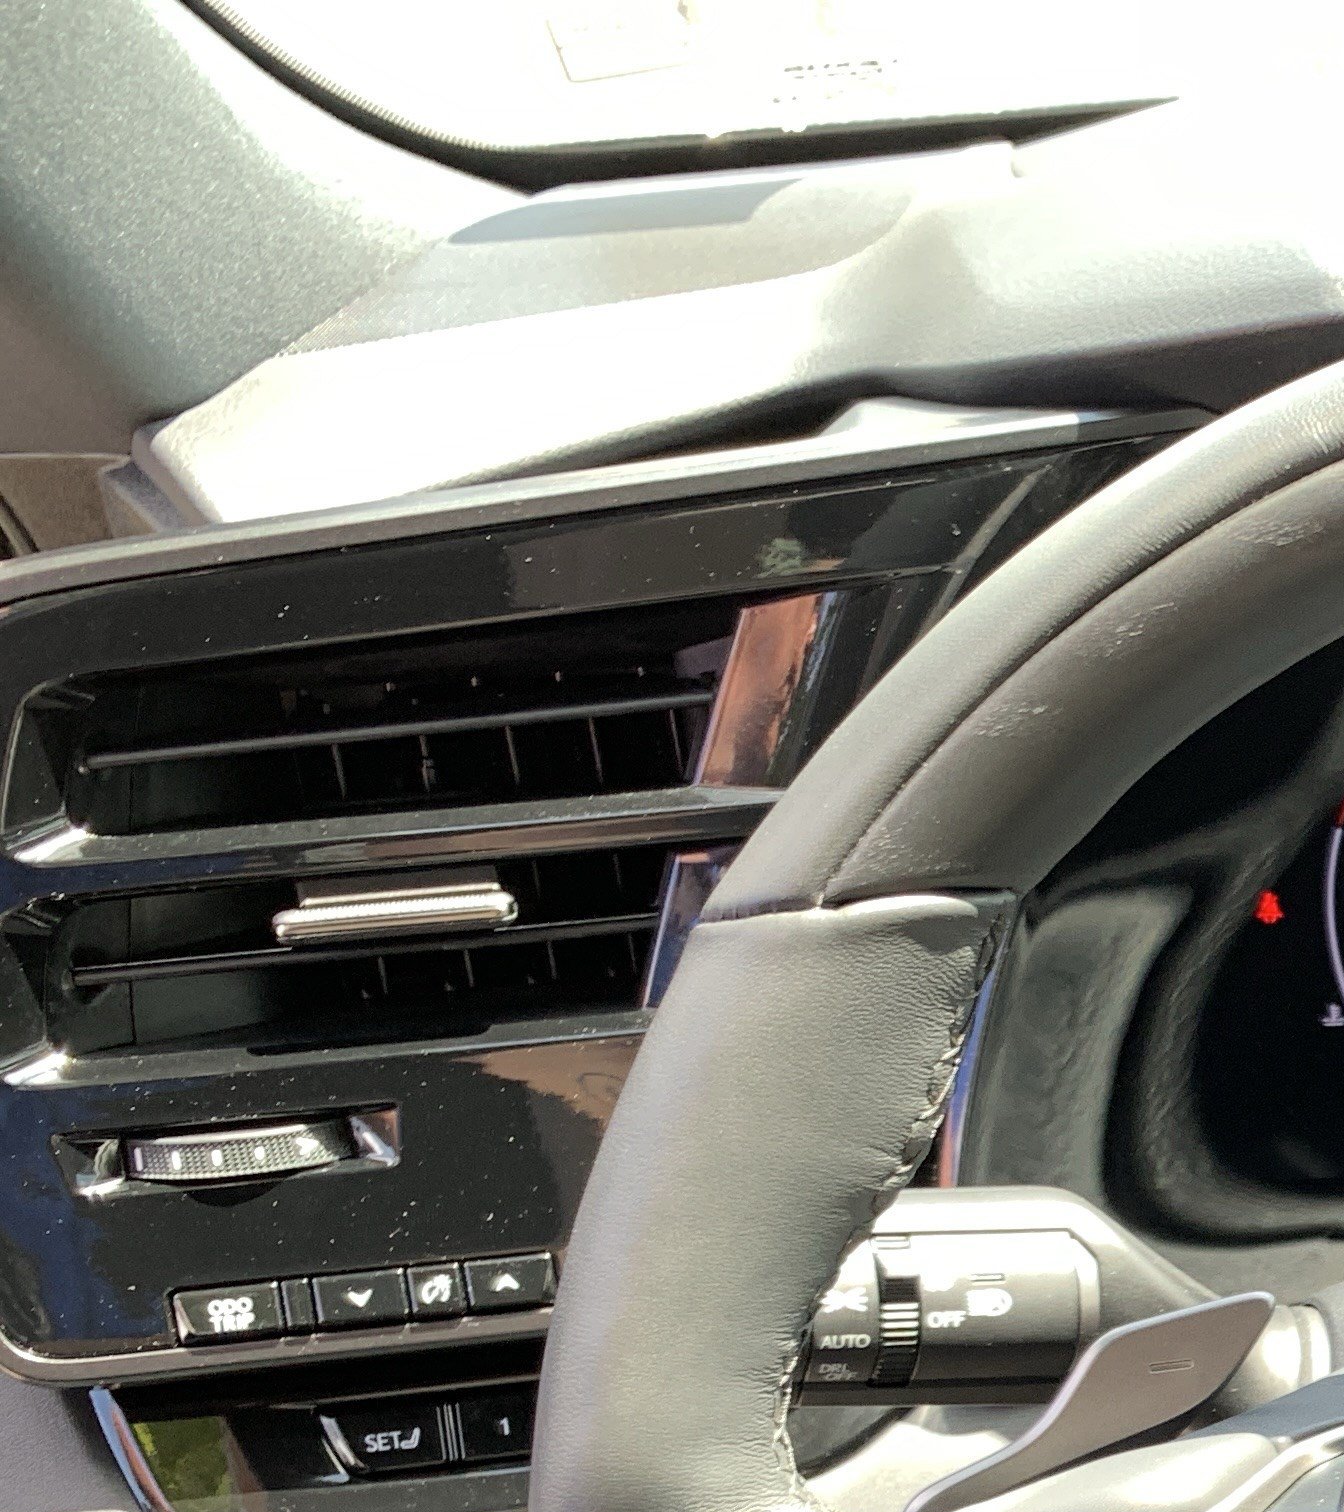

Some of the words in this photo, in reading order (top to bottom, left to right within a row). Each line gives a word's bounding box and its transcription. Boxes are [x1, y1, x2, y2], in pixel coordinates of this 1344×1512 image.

[207, 1296, 254, 1314] ODO
[208, 1311, 256, 1333] TRIP
[926, 1310, 966, 1329] OFF
[820, 1333, 871, 1350] AUTO
[818, 1362, 850, 1375] DRL
[499, 1416, 510, 1436] 1
[364, 1431, 401, 1453] SET
